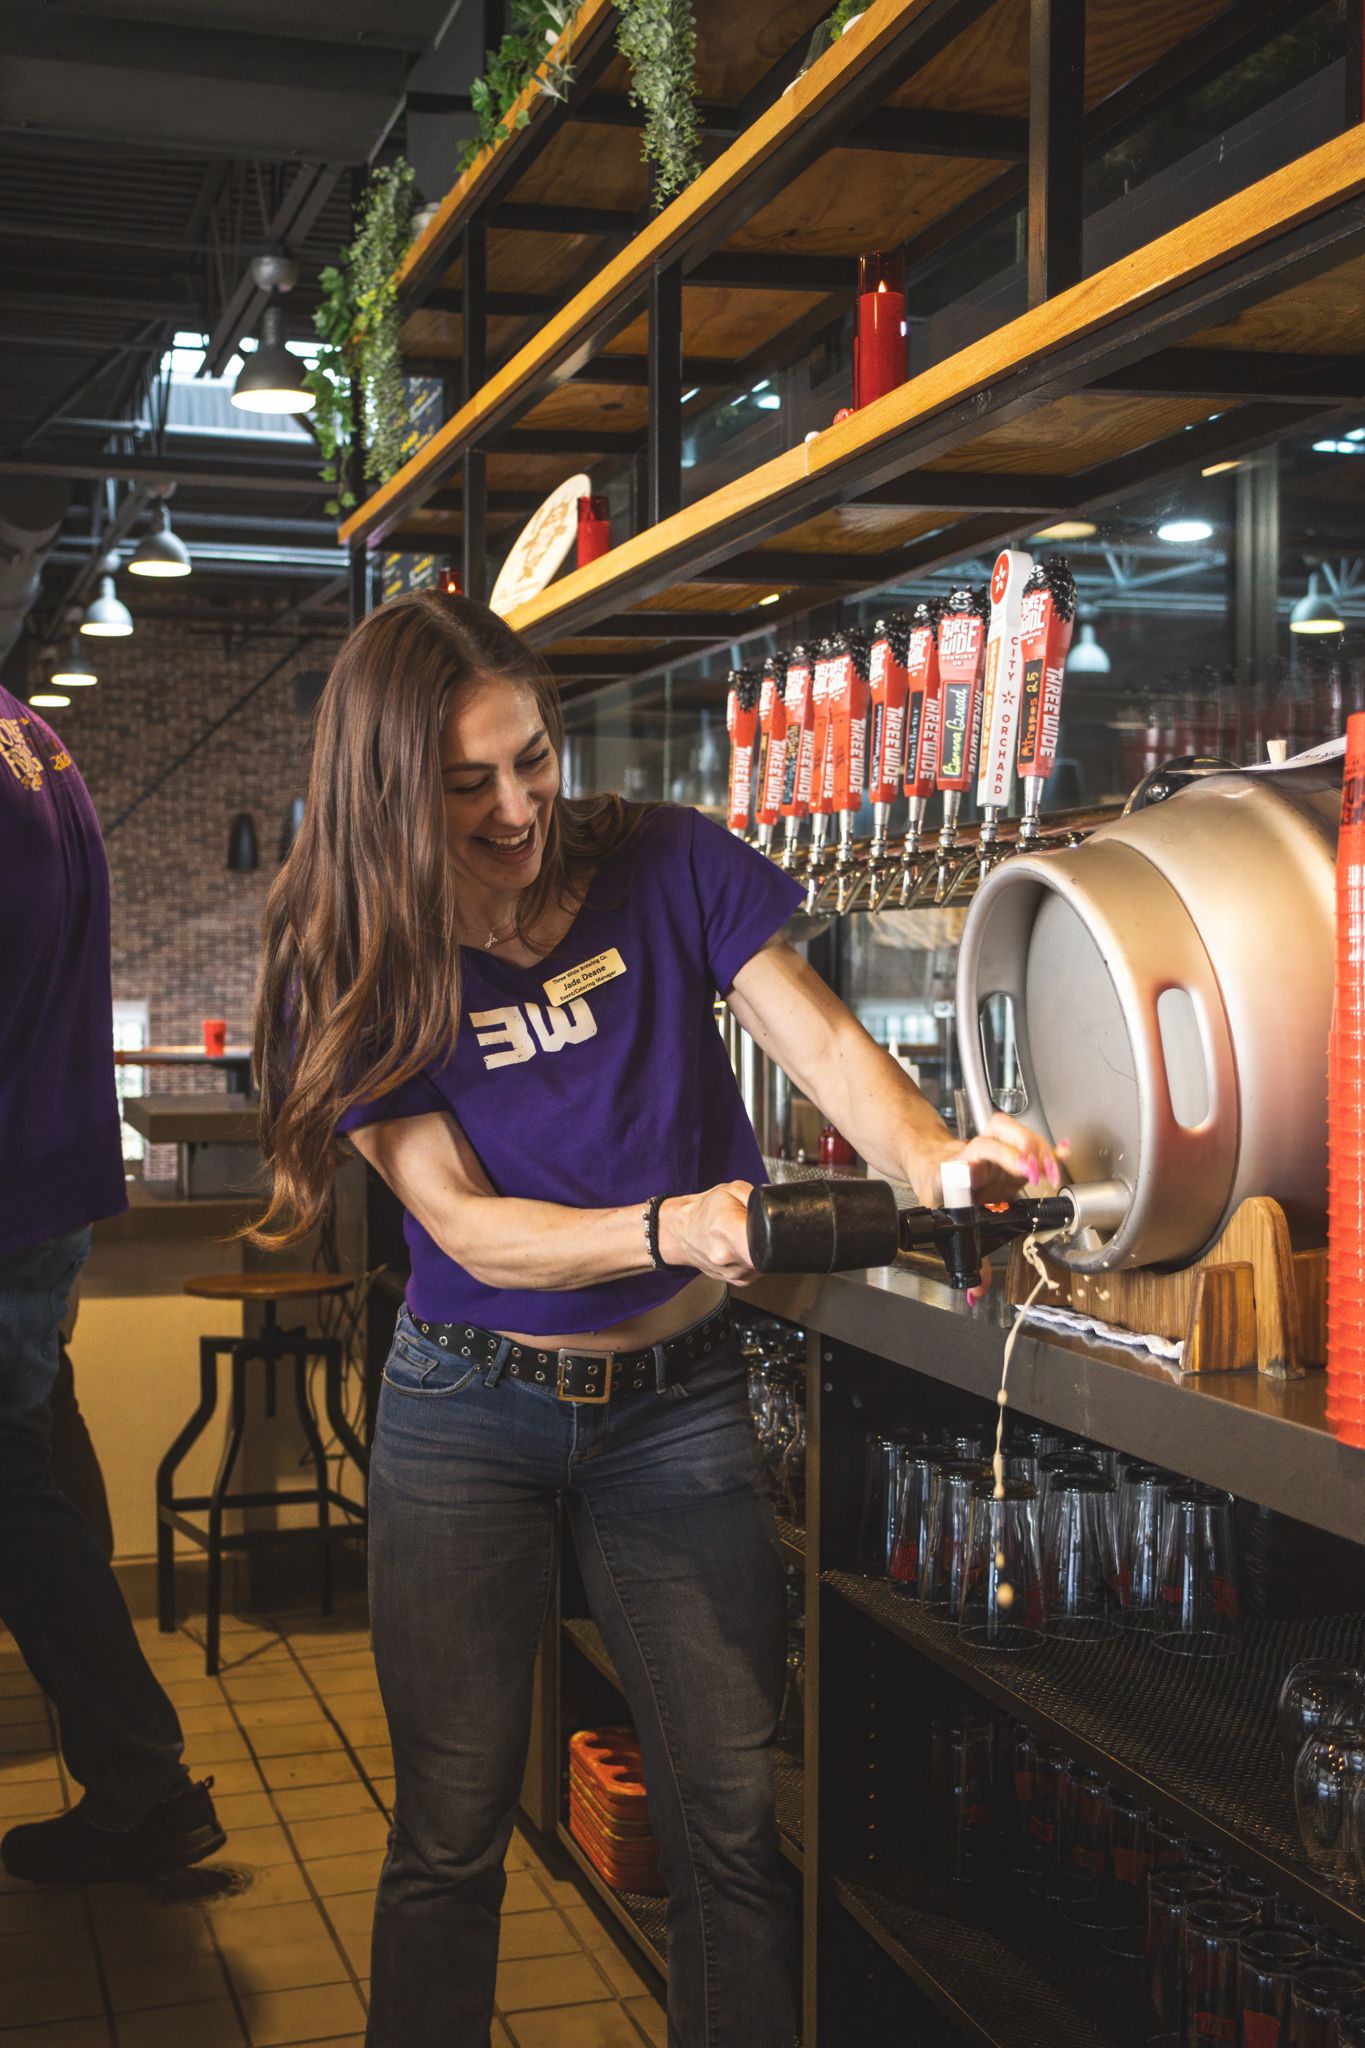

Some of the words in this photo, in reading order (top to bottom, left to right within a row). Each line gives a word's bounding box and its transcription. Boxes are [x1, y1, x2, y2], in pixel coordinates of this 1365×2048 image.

[941, 618, 981, 640] THREE
[940, 634, 977, 655] WIDE
[1008, 636, 1019, 681] CITY
[994, 714, 1011, 795] ORCHARD
[553, 976, 567, 985] Three
[567, 969, 580, 978] Wide
[580, 959, 600, 971] Brewing
[563, 978, 581, 991] Jade
[582, 965, 606, 981] Deane
[560, 981, 596, 1001] Event/Catering
[596, 970, 617, 983] Manager
